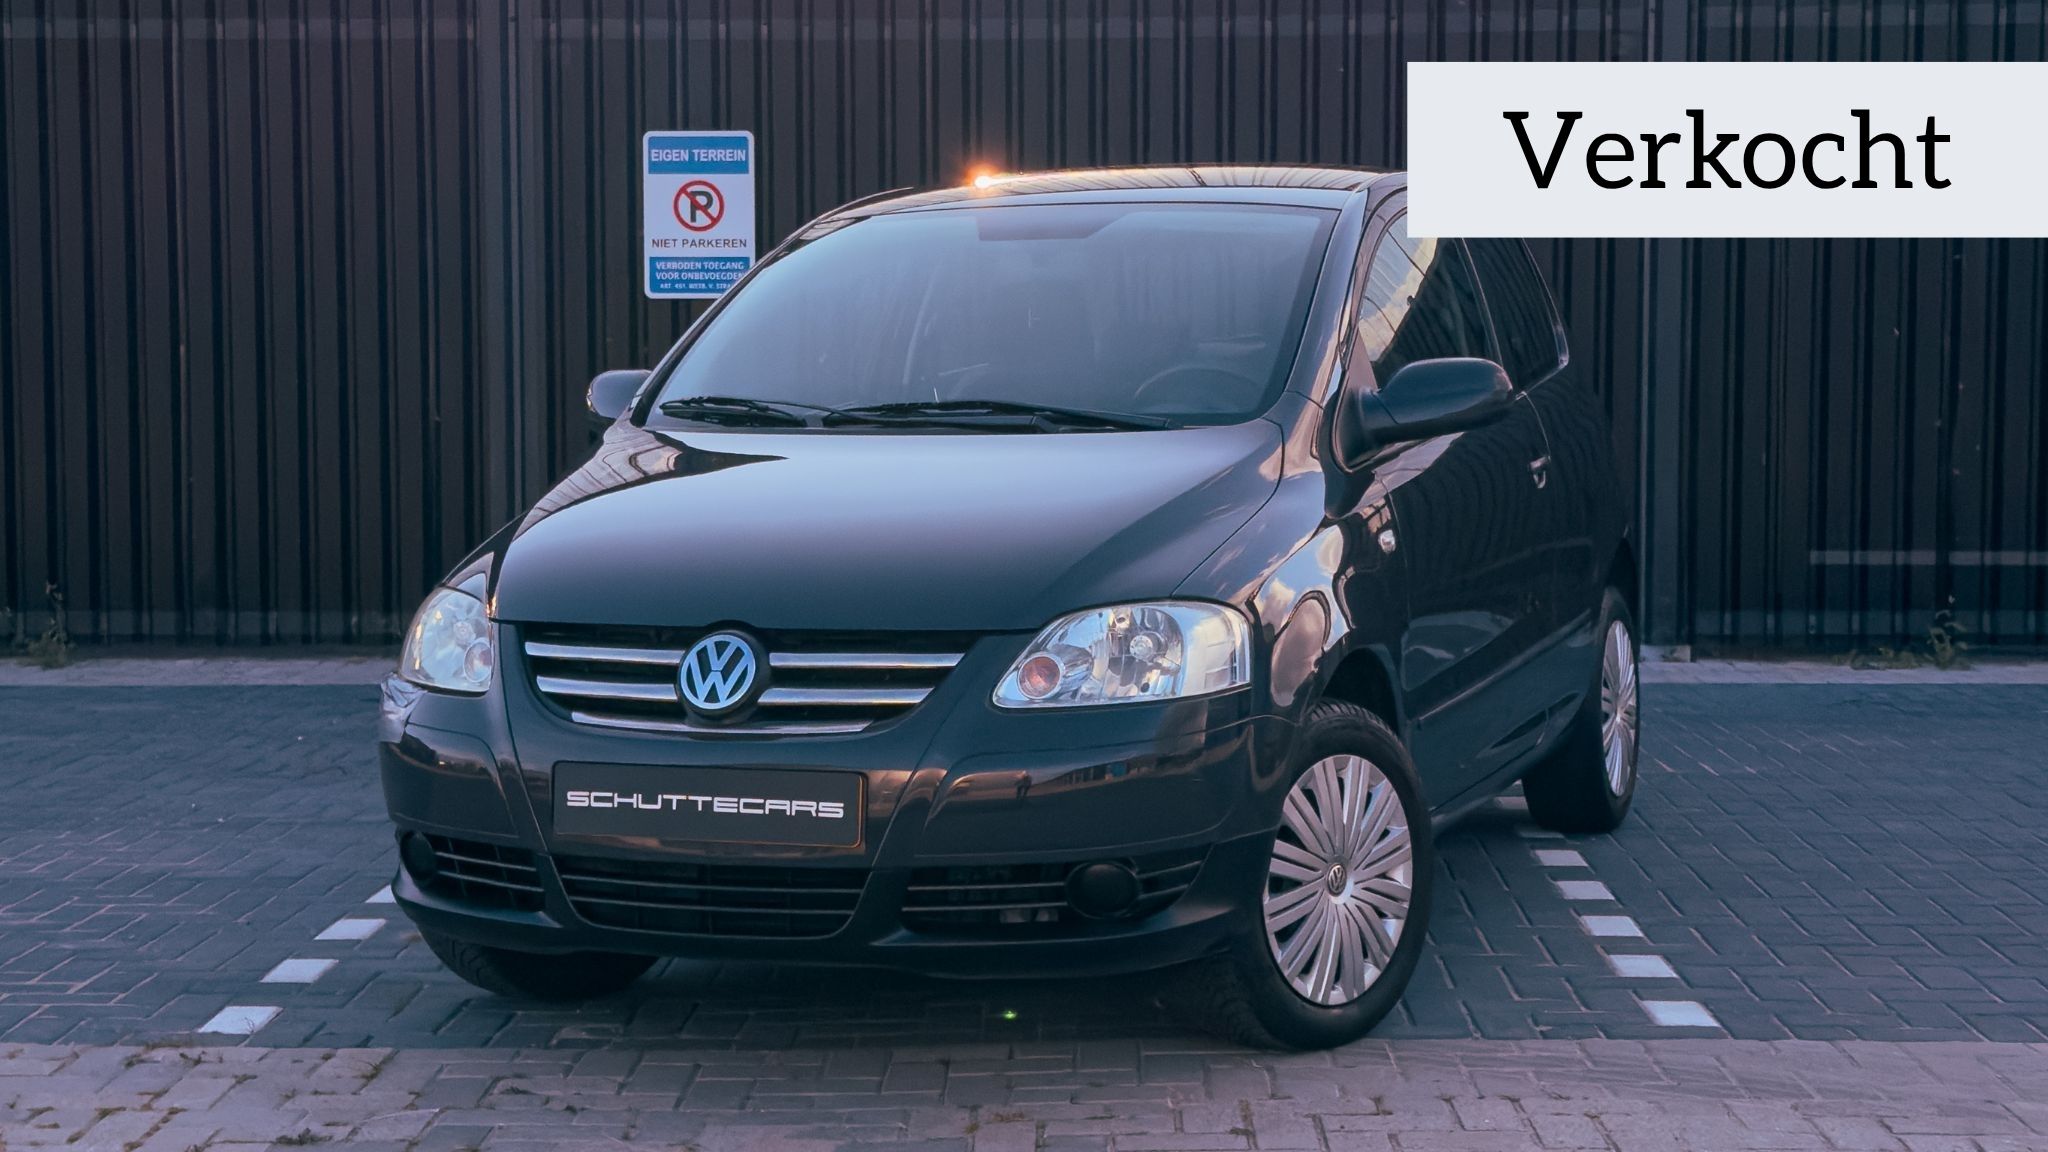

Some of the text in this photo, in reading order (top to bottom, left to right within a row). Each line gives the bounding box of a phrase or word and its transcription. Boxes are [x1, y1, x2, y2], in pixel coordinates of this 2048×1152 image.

[651, 149, 746, 162] EIGEN TERREIN
[651, 238, 747, 248] NIET PARKEREN
[655, 261, 744, 270] VERBODEN TOEGANG
[655, 271, 680, 280] VOOR
[566, 790, 844, 819] SCHUTTECARS
